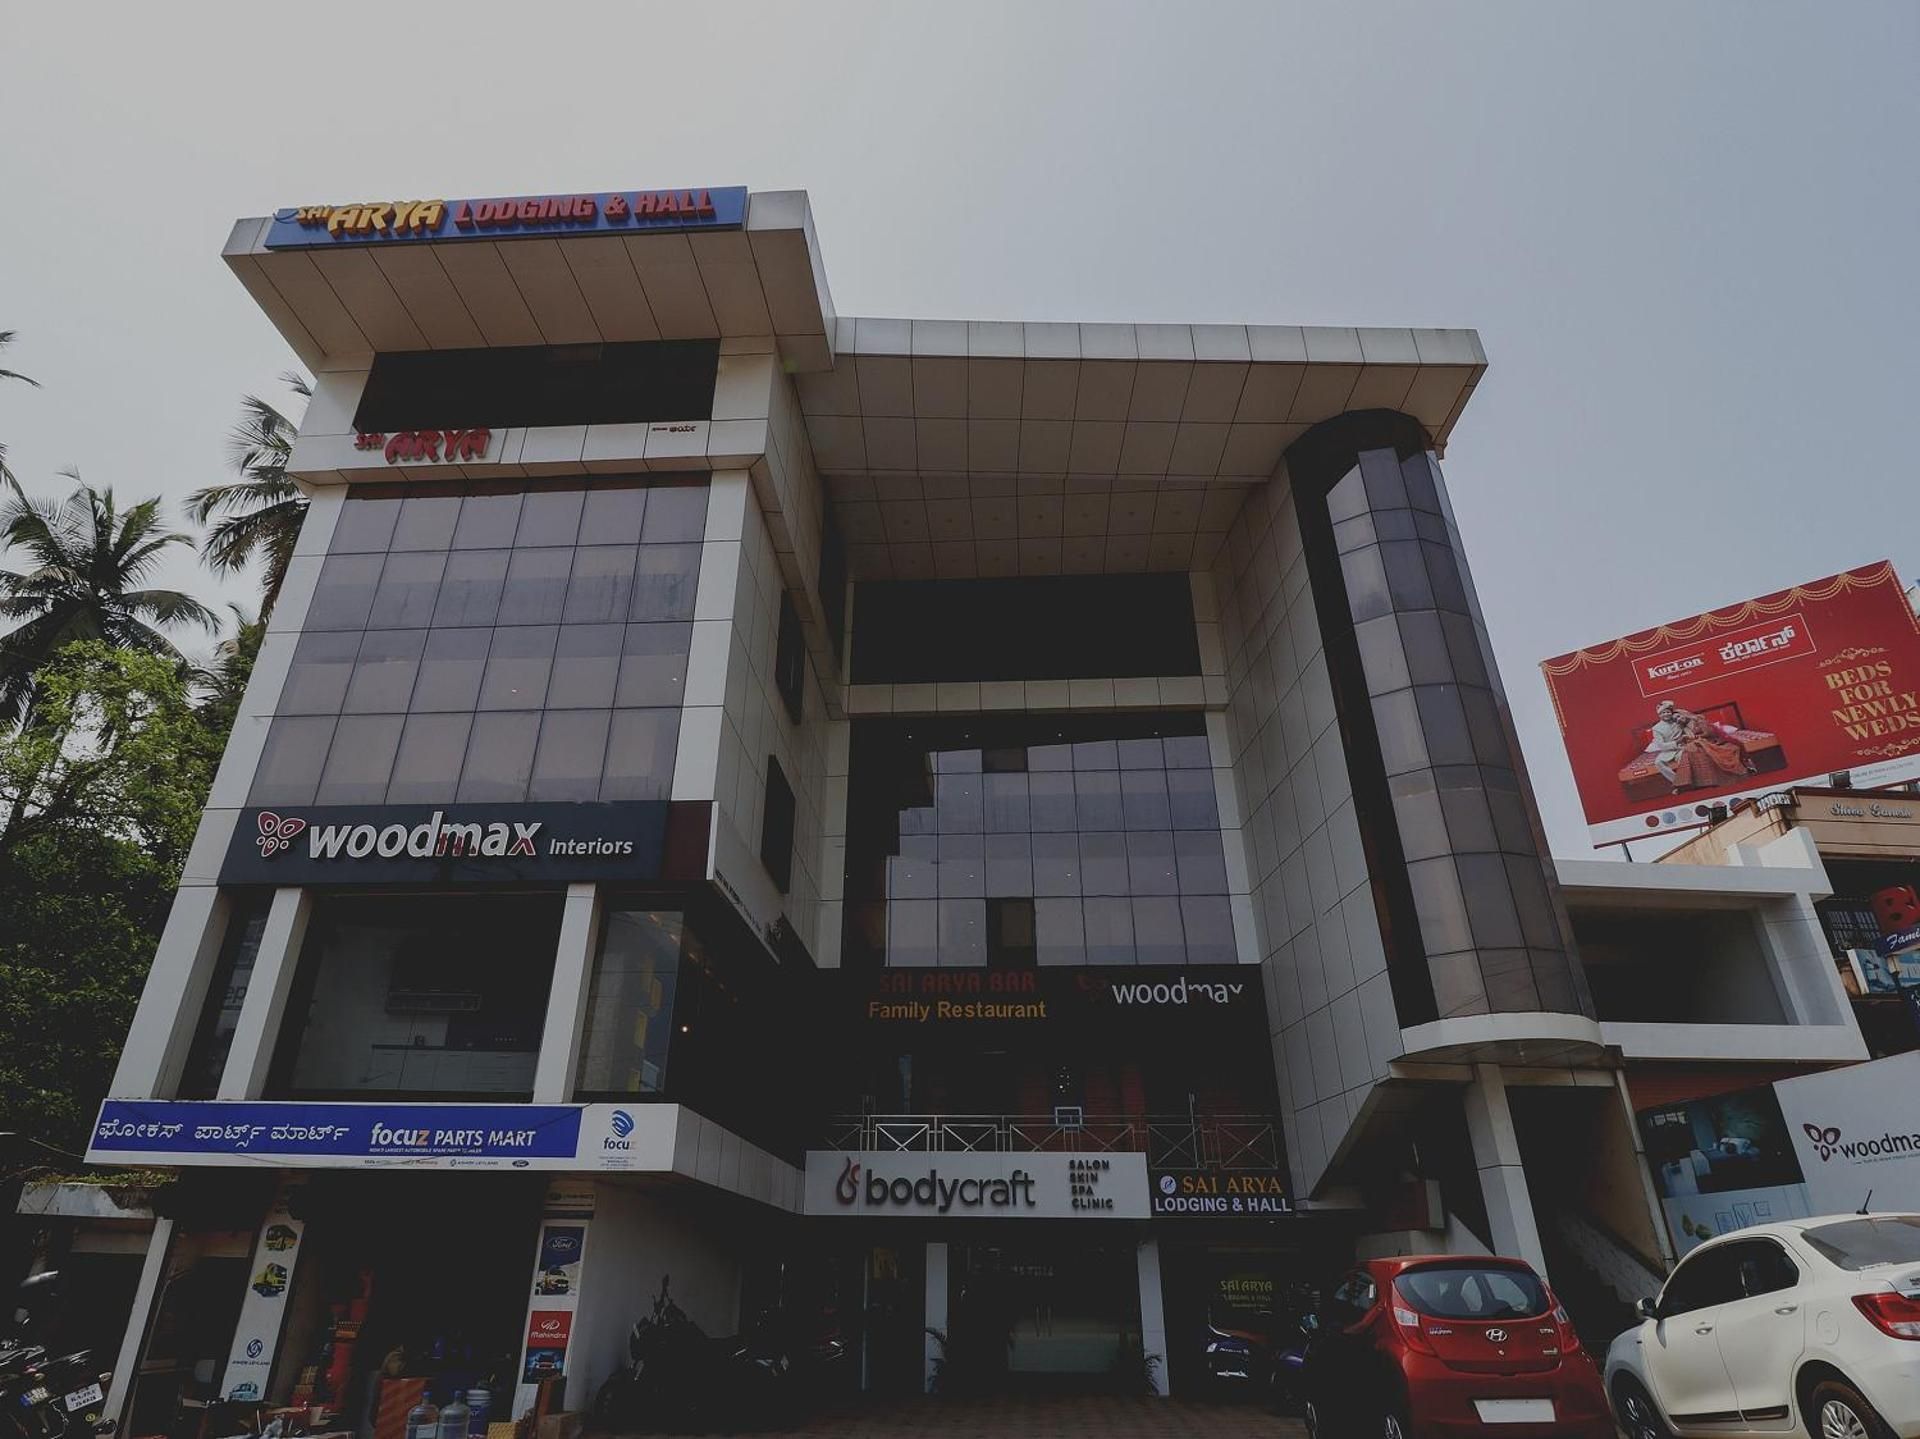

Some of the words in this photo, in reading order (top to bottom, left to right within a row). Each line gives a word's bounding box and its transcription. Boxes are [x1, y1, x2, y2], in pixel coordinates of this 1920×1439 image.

[297, 206, 332, 223] SAI
[328, 200, 446, 237] ARYA
[455, 199, 597, 228] LODGING
[604, 194, 630, 217] &
[634, 190, 716, 217] HALL
[384, 427, 491, 464] ARYA
[1825, 660, 1892, 690] BEDS
[1840, 680, 1893, 705] FOR
[1832, 691, 1918, 727] NEWLY
[1844, 711, 1920, 740] WEDS
[309, 811, 541, 858] woodmax
[549, 838, 633, 855] Interiors
[880, 972, 913, 993] SAI
[923, 972, 980, 993] ARYA
[869, 1001, 931, 1023] Family
[936, 1000, 1047, 1018] Restaurant
[369, 1121, 428, 1147] focuz
[433, 1129, 484, 1148] PARTS
[488, 1130, 536, 1148] MART
[1070, 1160, 1110, 1170] SALON
[1070, 1172, 1098, 1183] SKIN
[866, 1169, 1035, 1213] bodycraft
[1072, 1185, 1094, 1196] SPA
[1182, 1176, 1217, 1194] SAI
[1226, 1176, 1282, 1194] ARYA
[1072, 1198, 1113, 1209] CLINIC
[1154, 1197, 1227, 1212] LODGING
[1232, 1197, 1244, 1212] &
[1247, 1198, 1293, 1212] HALL
